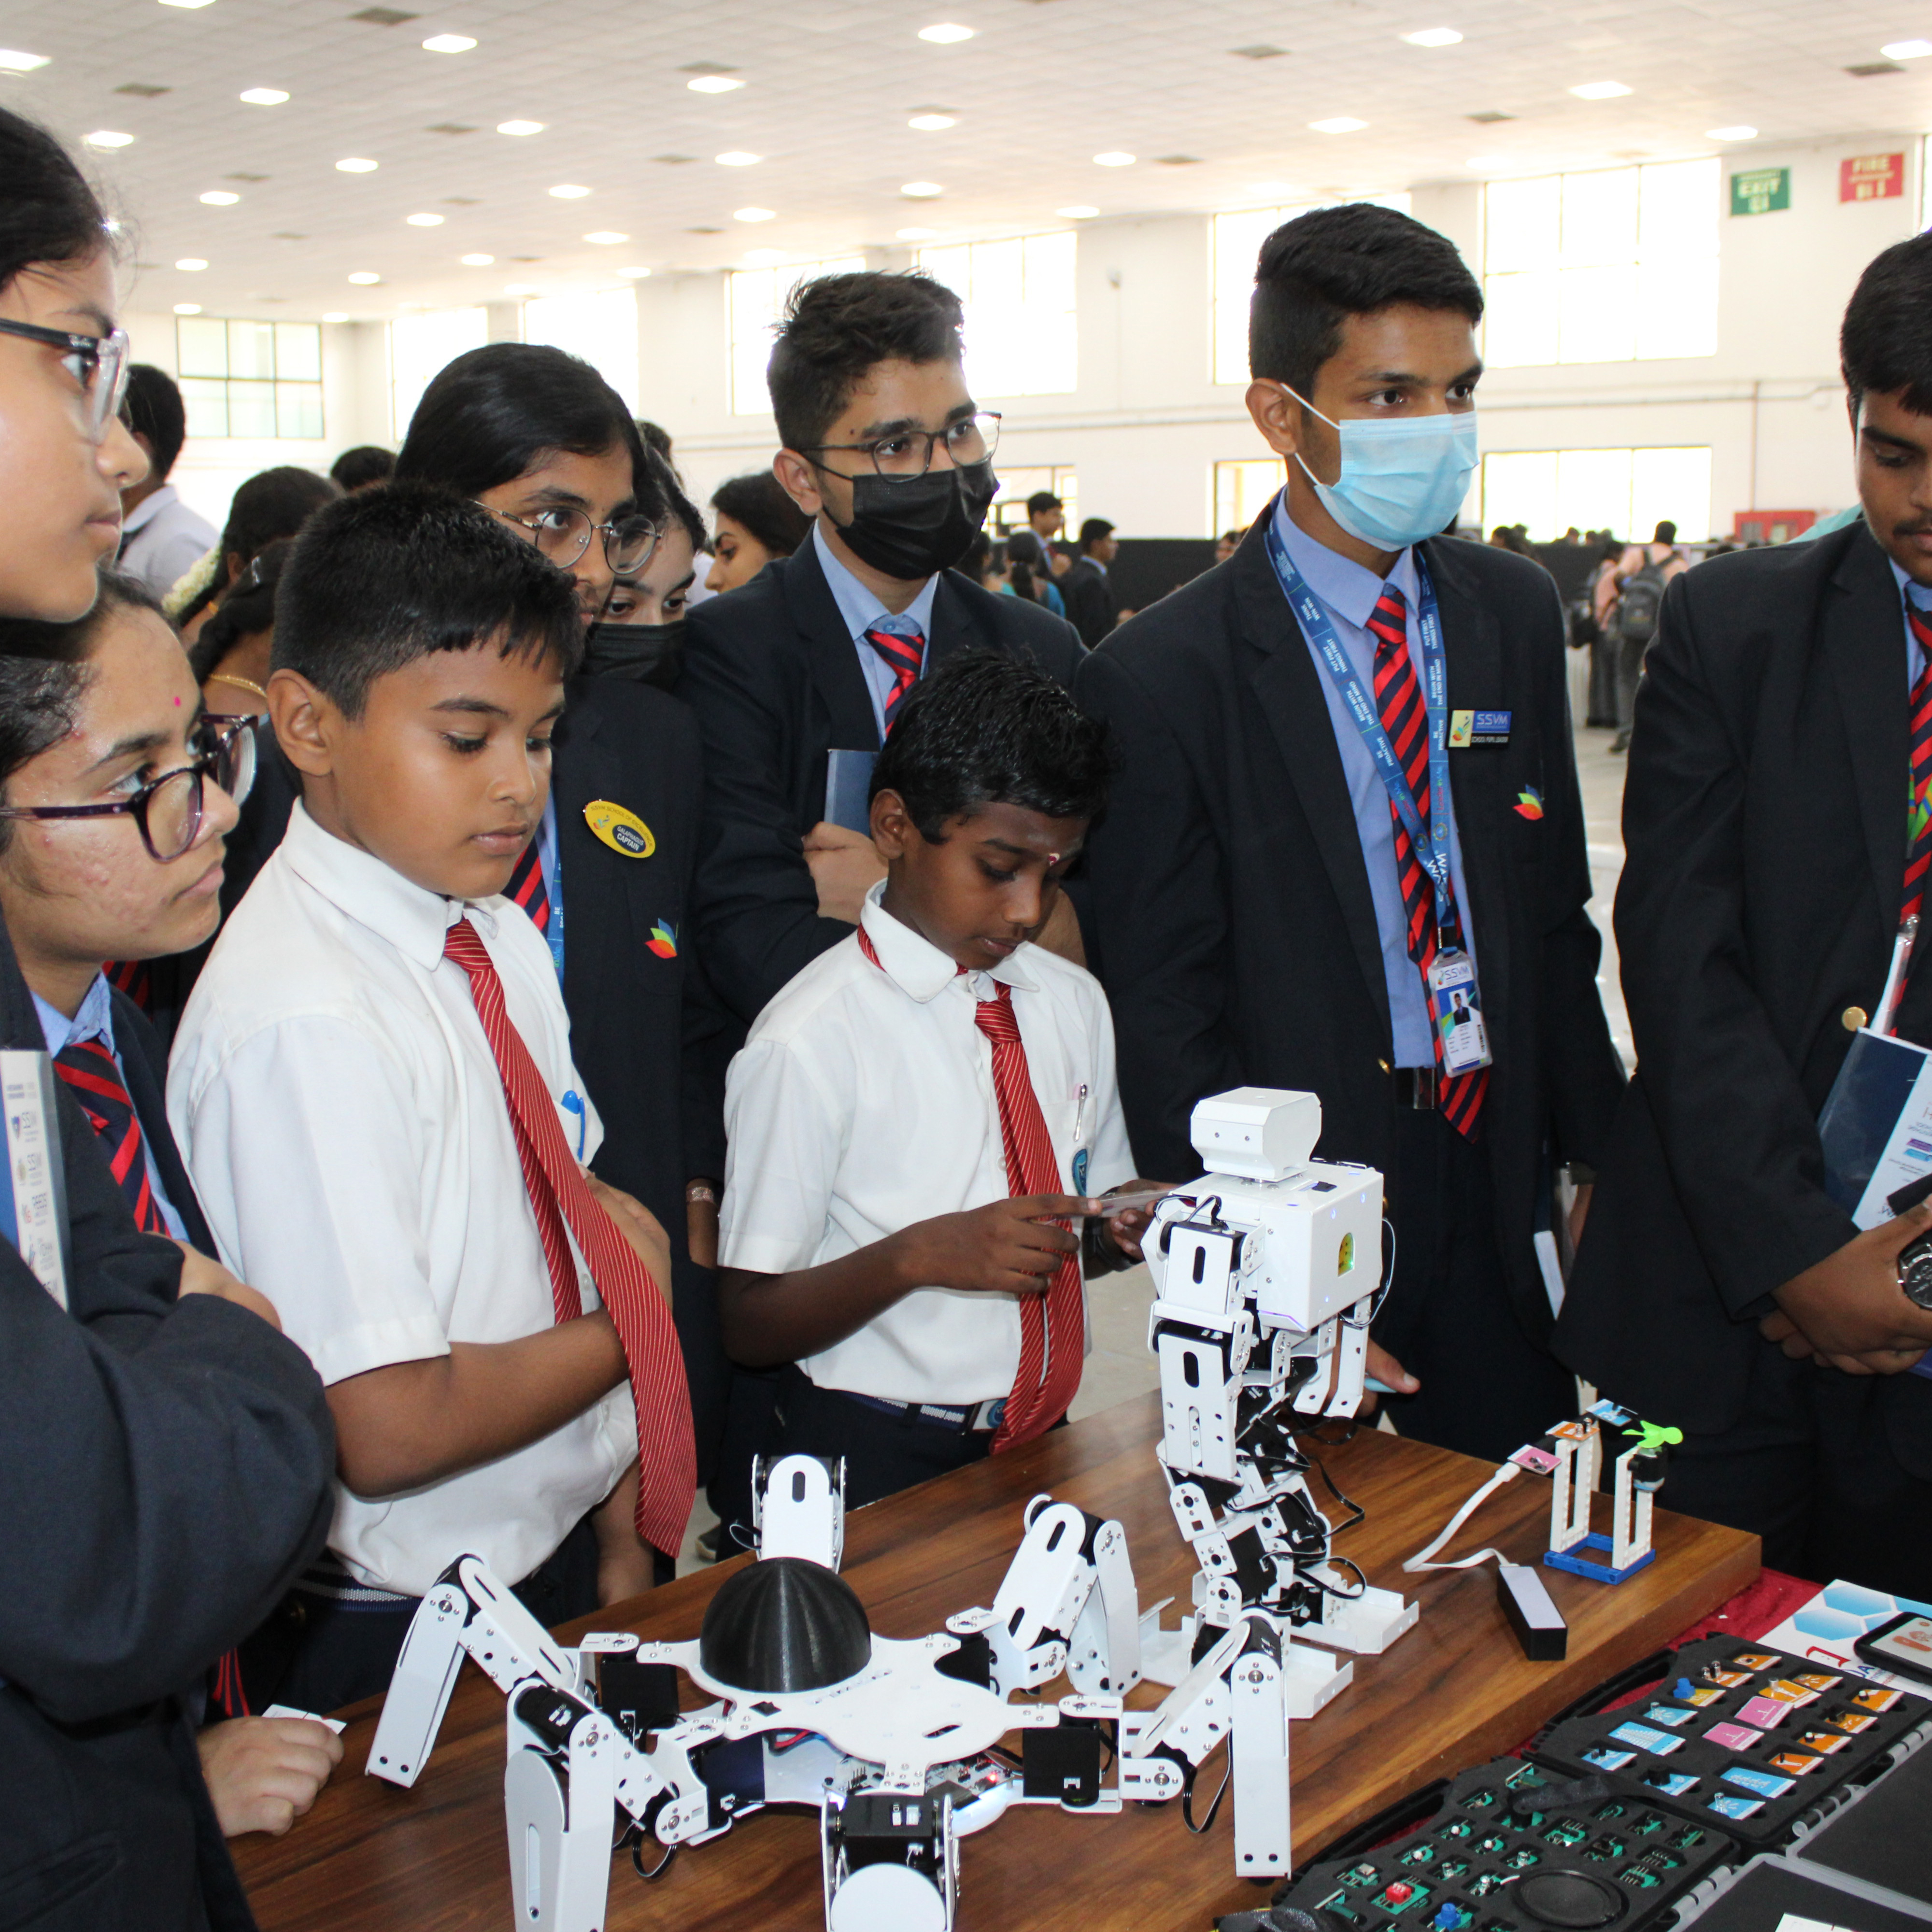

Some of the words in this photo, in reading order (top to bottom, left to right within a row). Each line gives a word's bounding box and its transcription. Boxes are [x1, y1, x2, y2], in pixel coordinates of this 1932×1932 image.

[1737, 178, 1780, 198] EXIT
[1301, 604, 1312, 621] THINK
[1421, 619, 1430, 635] FIRST
[1427, 613, 1435, 628] FIRST
[1326, 638, 1338, 653] FIRST
[1429, 628, 1438, 650] THINGS
[1323, 646, 1335, 661] FIRST
[1330, 660, 1340, 672] PUT
[1334, 652, 1348, 673] THINGS
[1349, 681, 1361, 696] MIND
[1346, 690, 1358, 705] WITH
[1353, 704, 1366, 722] BEGIN
[1360, 702, 1370, 714] END
[1365, 713, 1375, 725] THE
[1477, 713, 1508, 725] SSVM
[1433, 731, 1438, 739] BE
[1376, 750, 1384, 759] BE
[1377, 736, 1394, 767] PROACTIVE
[606, 806, 625, 817] SCHOOL
[617, 833, 640, 851] CAPTAIN
